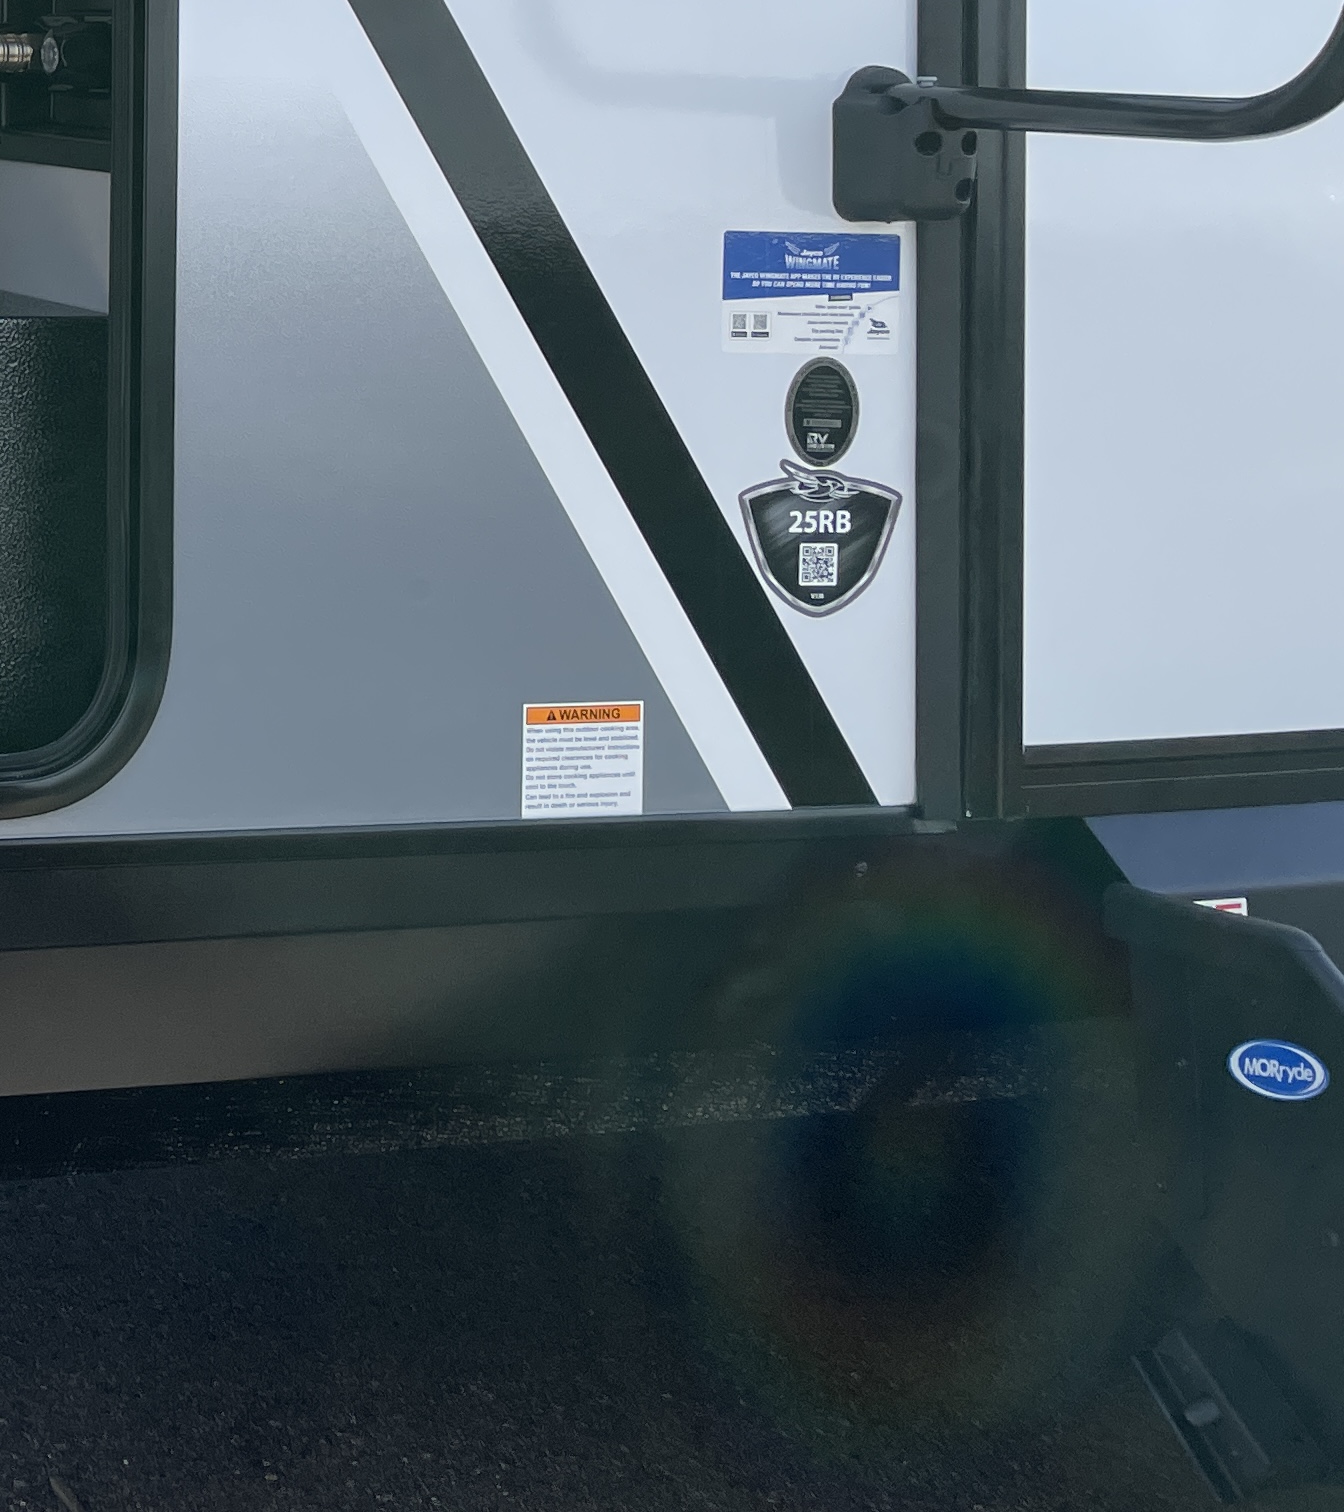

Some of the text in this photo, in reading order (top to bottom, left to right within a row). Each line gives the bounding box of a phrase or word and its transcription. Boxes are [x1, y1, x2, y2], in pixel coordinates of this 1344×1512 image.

[784, 254, 840, 270] WINGMATE
[788, 510, 852, 534] 25RB
[559, 708, 621, 720] WARNING
[1244, 1057, 1313, 1084] MORryde
